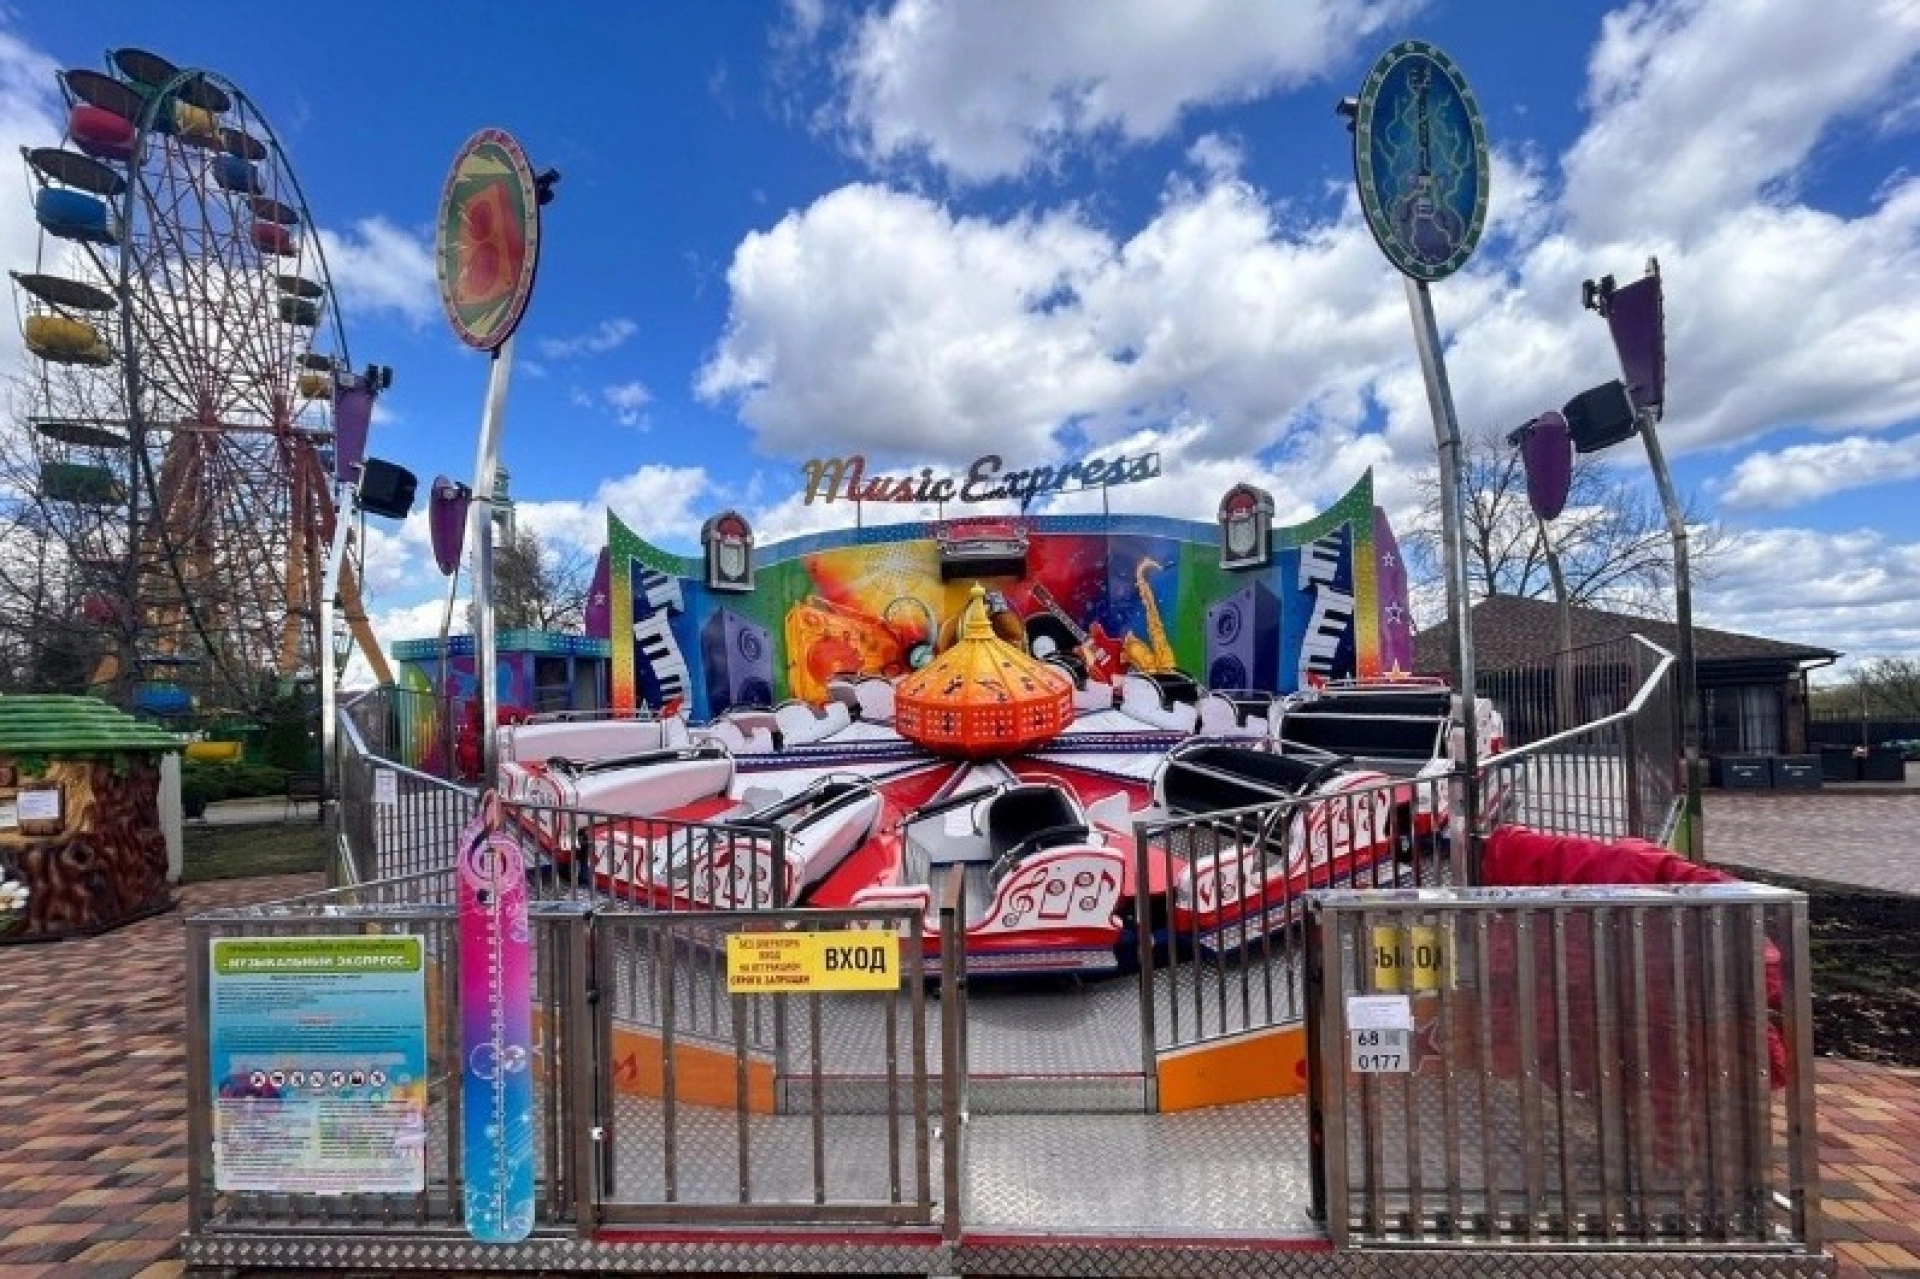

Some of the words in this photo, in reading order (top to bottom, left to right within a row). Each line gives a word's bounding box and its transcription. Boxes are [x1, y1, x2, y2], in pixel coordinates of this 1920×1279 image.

[802, 455, 957, 506] Music
[960, 453, 1161, 508] Express
[825, 946, 887, 973] ВХОД
[1358, 1030, 1379, 1046] 68
[1358, 1055, 1400, 1070] 0177
